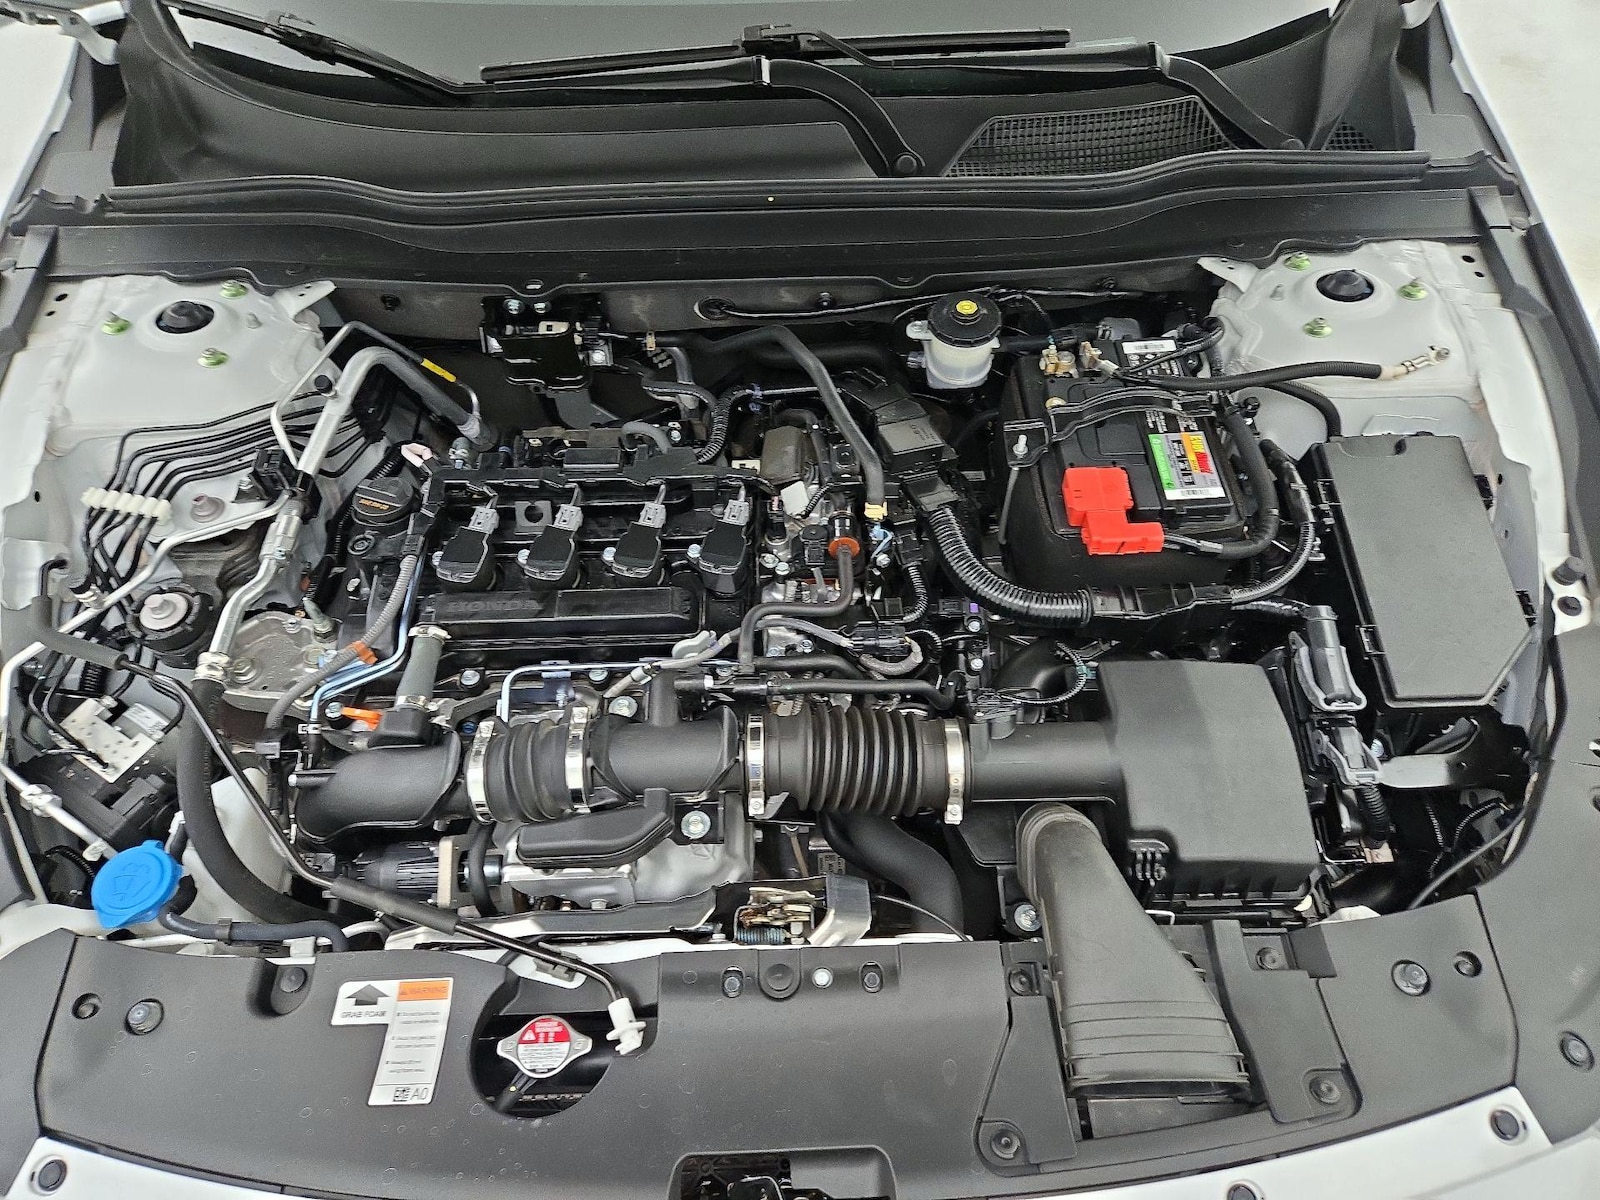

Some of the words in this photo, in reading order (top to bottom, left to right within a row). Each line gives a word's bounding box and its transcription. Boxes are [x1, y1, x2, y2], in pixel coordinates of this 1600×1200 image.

[446, 599, 543, 613] HONDA
[410, 986, 448, 995] WARNING
[340, 1011, 362, 1019] GRAB
[364, 1010, 387, 1018] FOAM
